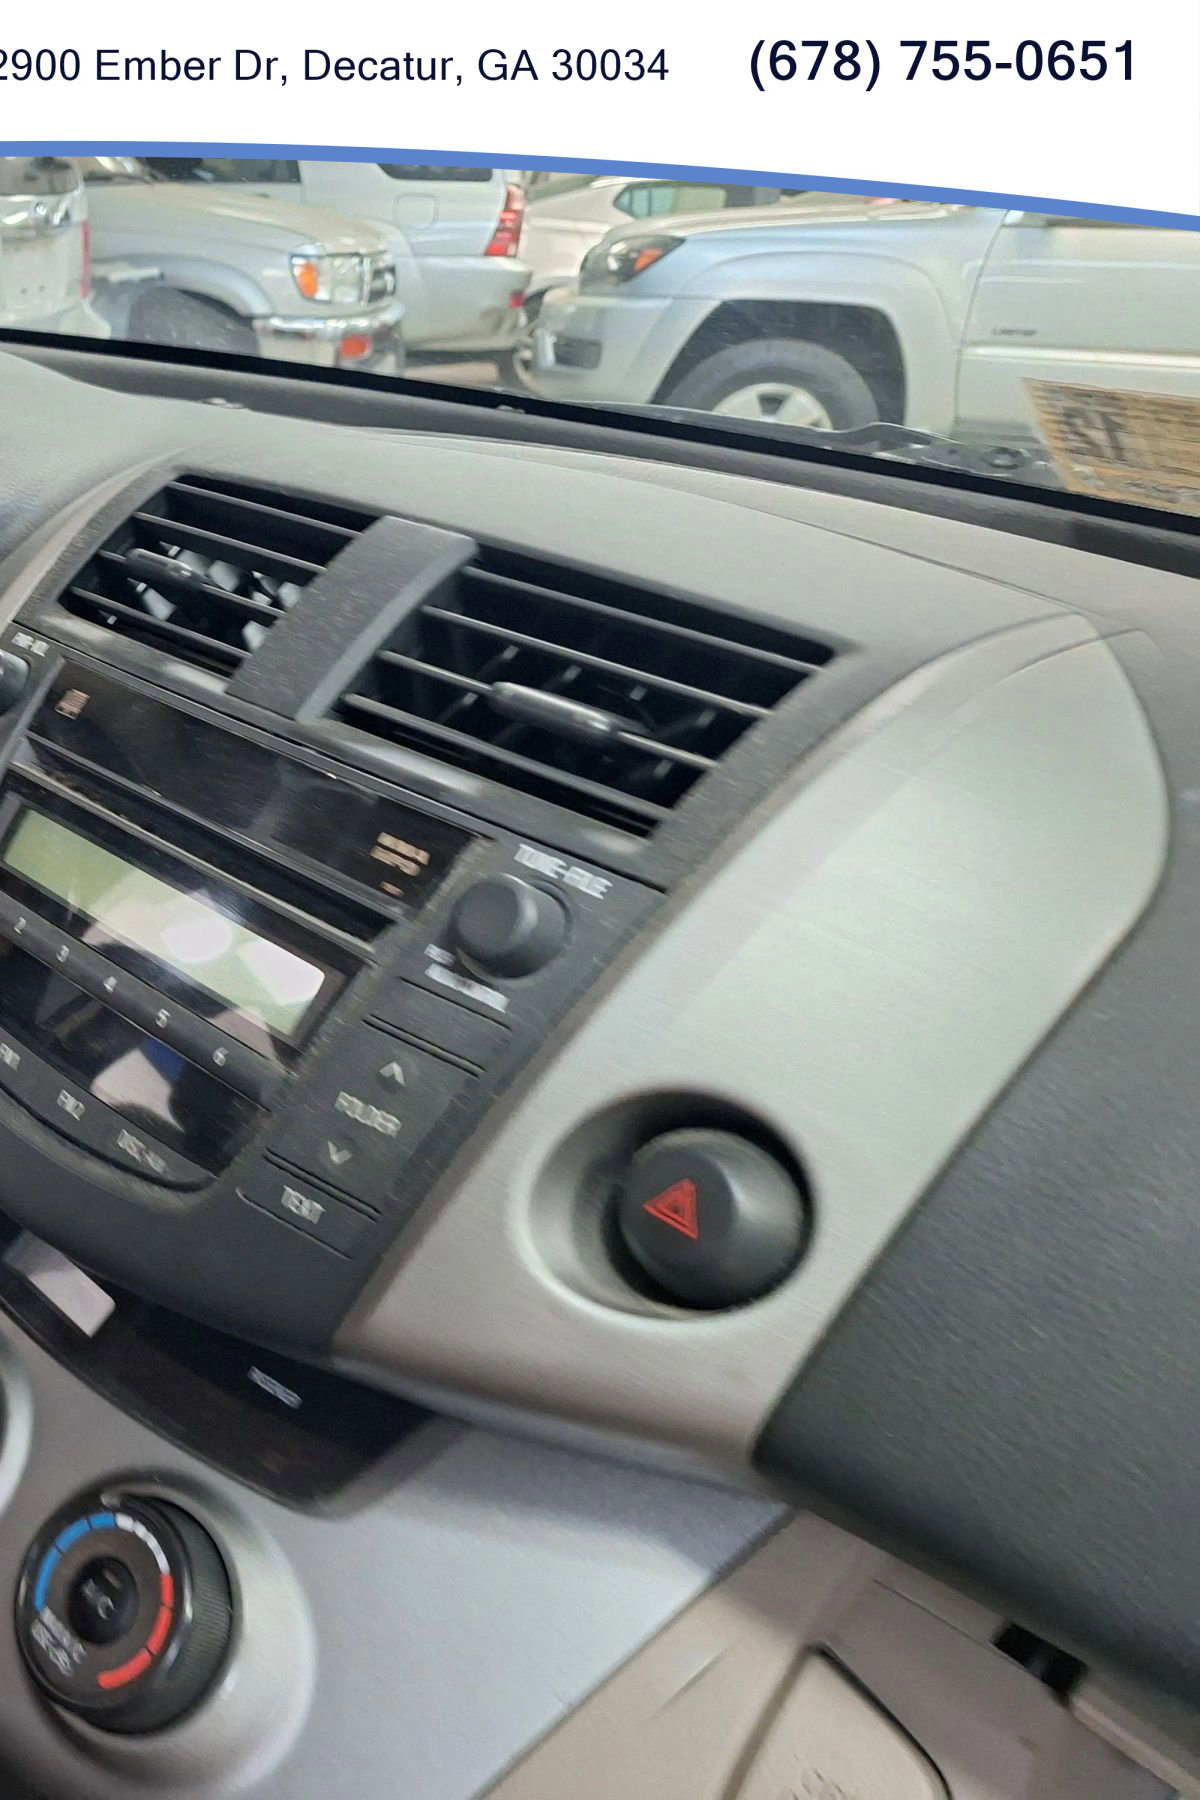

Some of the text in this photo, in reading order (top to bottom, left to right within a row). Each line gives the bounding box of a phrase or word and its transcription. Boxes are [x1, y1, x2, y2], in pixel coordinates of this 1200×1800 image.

[13, 916, 28, 935] 2
[56, 944, 70, 963] 3
[155, 1007, 172, 1029] 5
[212, 1046, 229, 1067] 6
